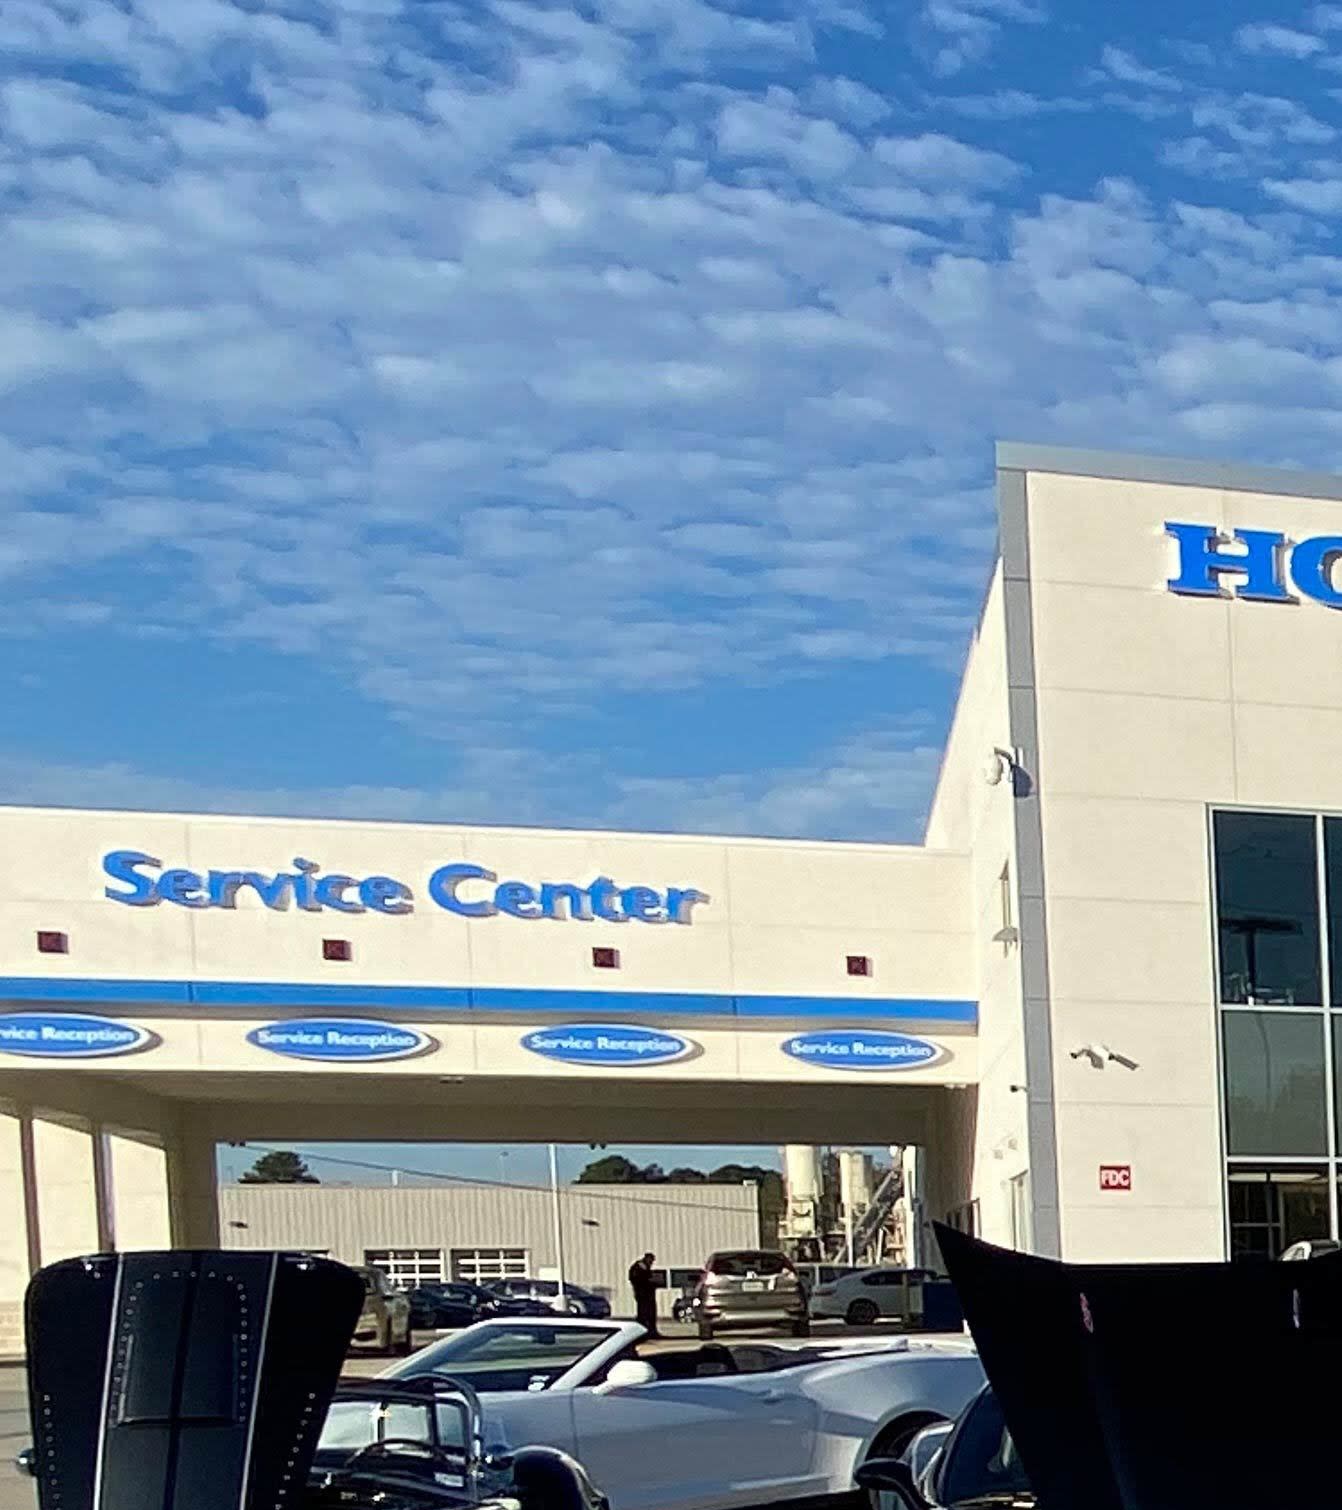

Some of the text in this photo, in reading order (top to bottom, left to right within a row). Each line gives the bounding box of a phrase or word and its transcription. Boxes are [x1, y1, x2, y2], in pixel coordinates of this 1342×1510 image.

[101, 850, 710, 925] Service Center
[41, 1026, 135, 1044] Reception
[257, 1029, 417, 1049] Service Reception
[530, 1034, 681, 1054] Service Reception
[791, 1039, 931, 1058] Service Reception
[1101, 1169, 1130, 1186] FDC
